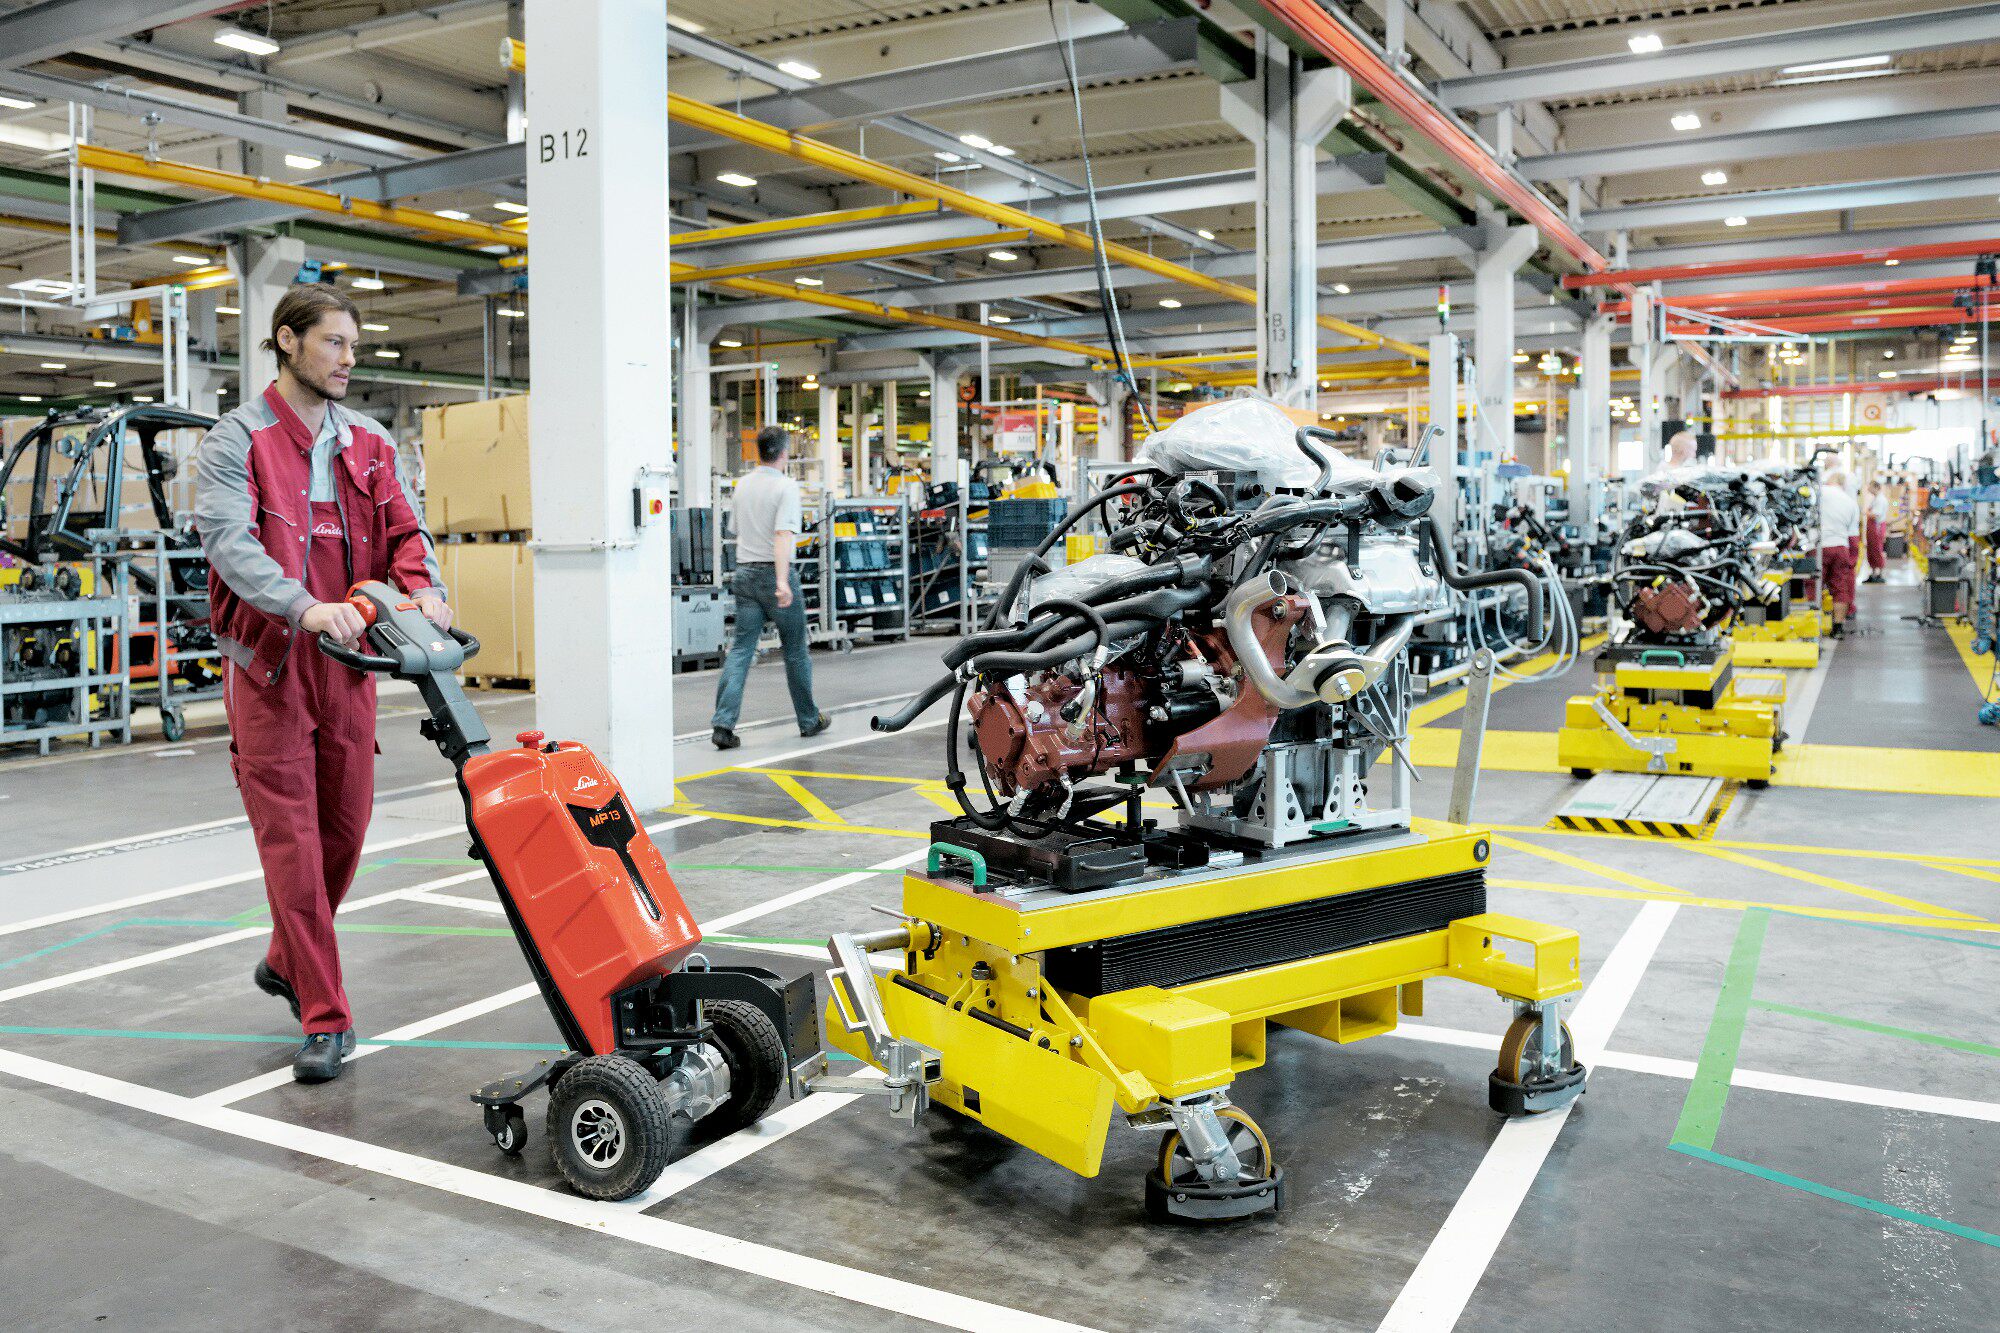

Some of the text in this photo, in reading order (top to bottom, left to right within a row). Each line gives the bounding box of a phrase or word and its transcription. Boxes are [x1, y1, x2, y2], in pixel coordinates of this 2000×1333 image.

[1272, 313, 1282, 328] B
[1272, 328, 1286, 343] 13
[689, 600, 712, 614] Linde
[573, 775, 599, 791] Linde
[589, 809, 622, 828] MP 13
